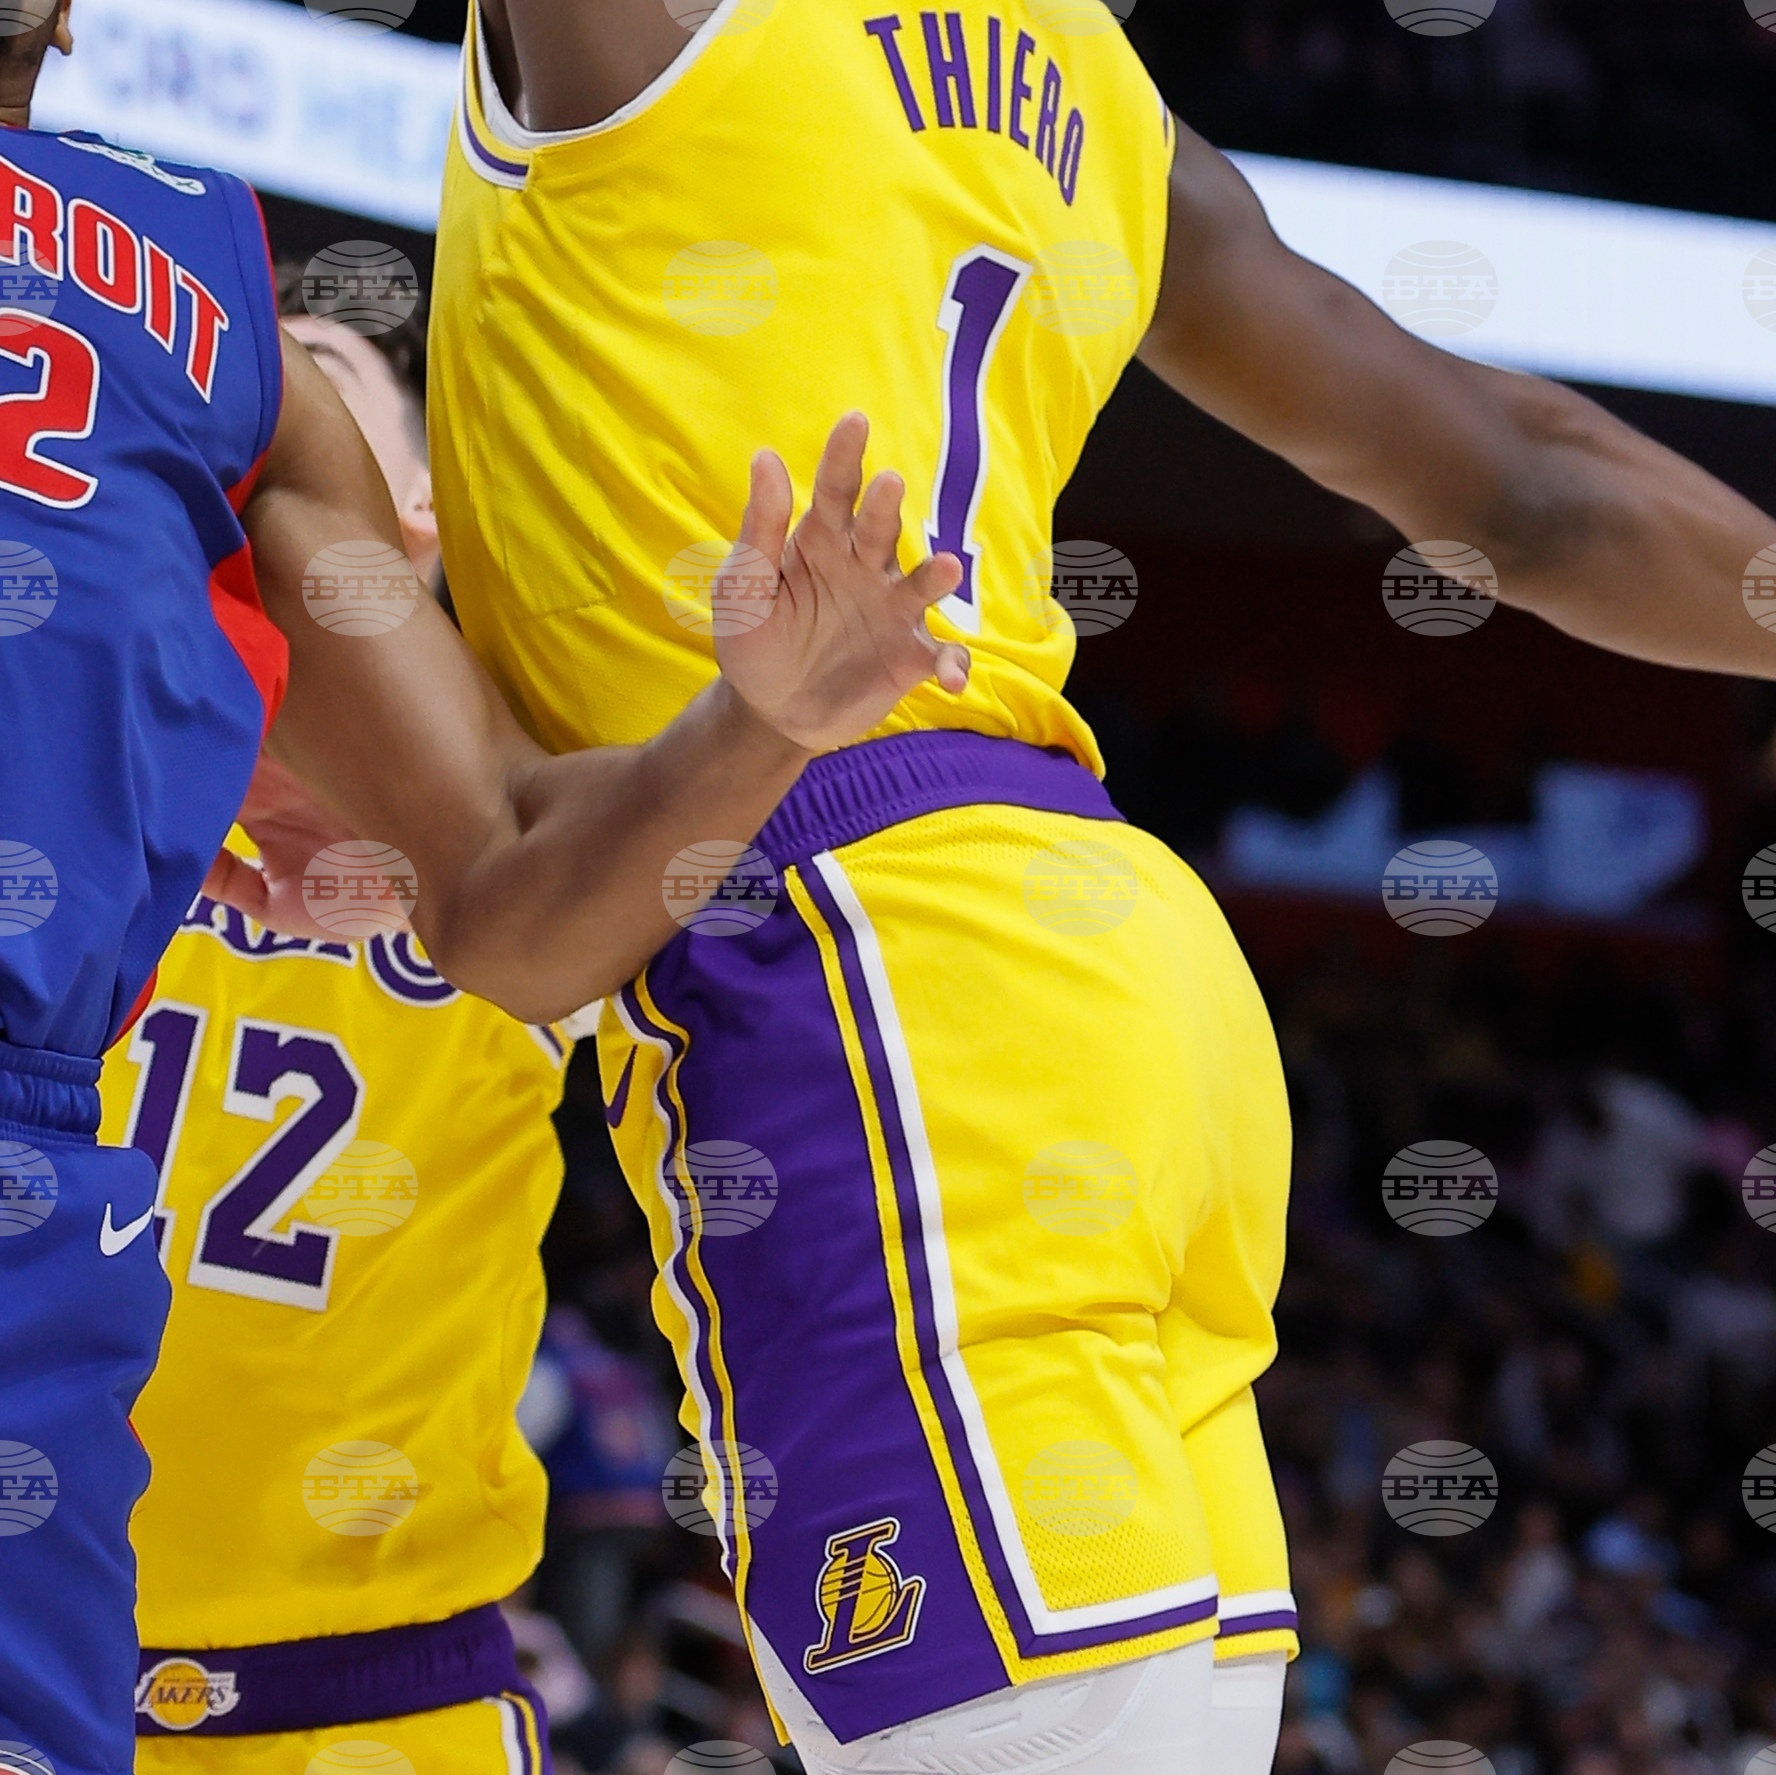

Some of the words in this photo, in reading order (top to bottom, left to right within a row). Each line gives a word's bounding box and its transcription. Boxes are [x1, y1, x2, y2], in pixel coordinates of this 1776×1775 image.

[864, 11, 1086, 208] THIERO
[923, 242, 1033, 634] 1
[126, 998, 366, 1312] 12
